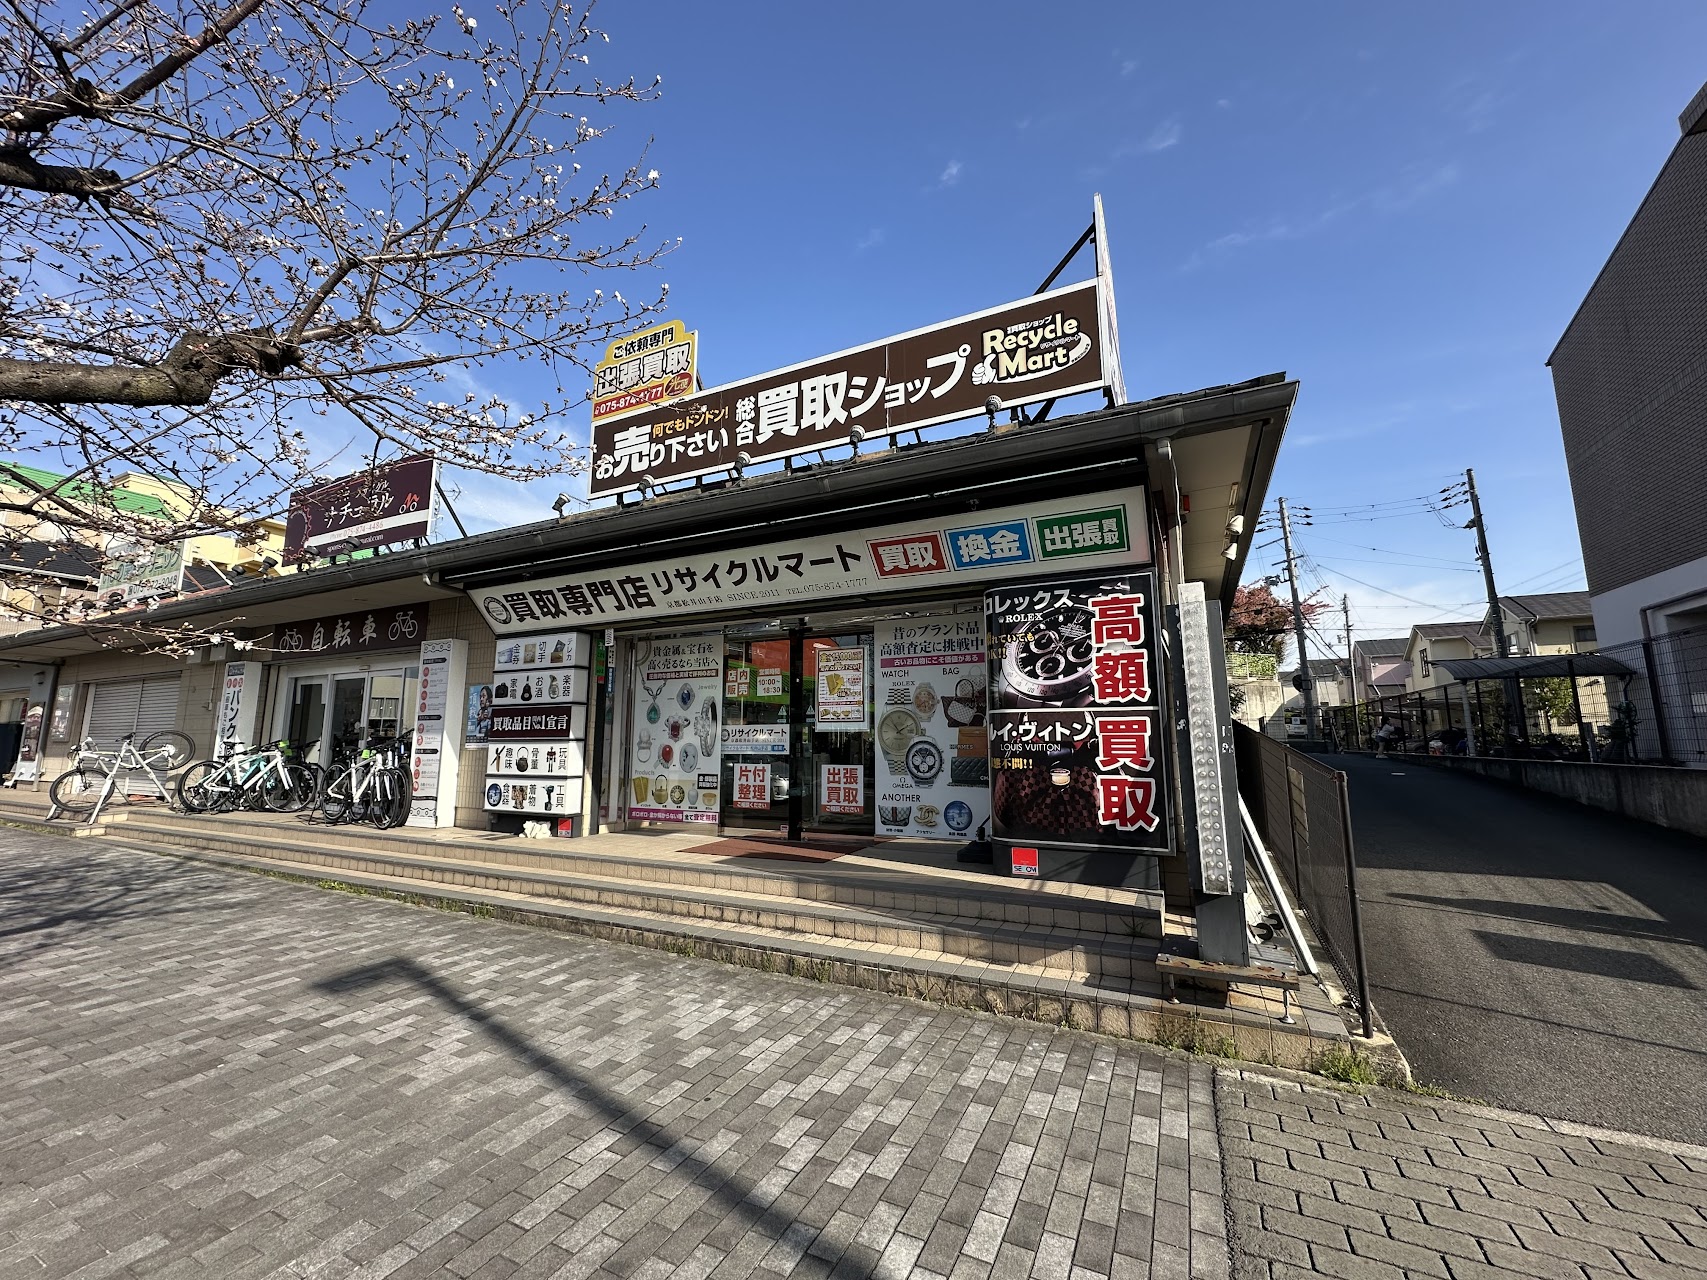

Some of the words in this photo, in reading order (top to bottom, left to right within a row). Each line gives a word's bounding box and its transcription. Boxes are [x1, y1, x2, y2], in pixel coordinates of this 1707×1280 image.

[613, 326, 675, 359] ご依頼専門
[982, 312, 1078, 356] Recycle
[596, 343, 690, 399] 出張買取
[998, 347, 1069, 378] Mart
[756, 343, 972, 445] 買取ショップ
[595, 425, 729, 480] お売り下さい
[877, 541, 938, 572] 買取
[957, 529, 1022, 563] 換金
[759, 588, 781, 599] 2011
[985, 588, 1075, 615] ロレックス
[1005, 612, 1043, 623] ROLEX
[310, 614, 377, 650] 自転車
[893, 620, 980, 641] 昔のブランド品
[538, 641, 547, 663] 切手
[880, 636, 984, 657] 高額査定に挑戦中
[647, 656, 719, 671] 高く売るなら当店へ
[881, 669, 909, 679] WATCH
[942, 667, 960, 676] BAG
[562, 674, 571, 697] 楽器
[698, 683, 718, 691] Jewelry
[730, 728, 787, 738] リサイクルマート
[1000, 743, 1022, 751] LOUIS
[1024, 743, 1061, 751] VUITTON
[558, 747, 568, 770] 玩具
[738, 766, 766, 782] 片付
[827, 767, 859, 784] 出張
[528, 783, 537, 807] 着物
[555, 784, 565, 808] 工具
[737, 784, 766, 800] 整理
[826, 786, 859, 804] 買取
[882, 793, 921, 803] ANOTHER
